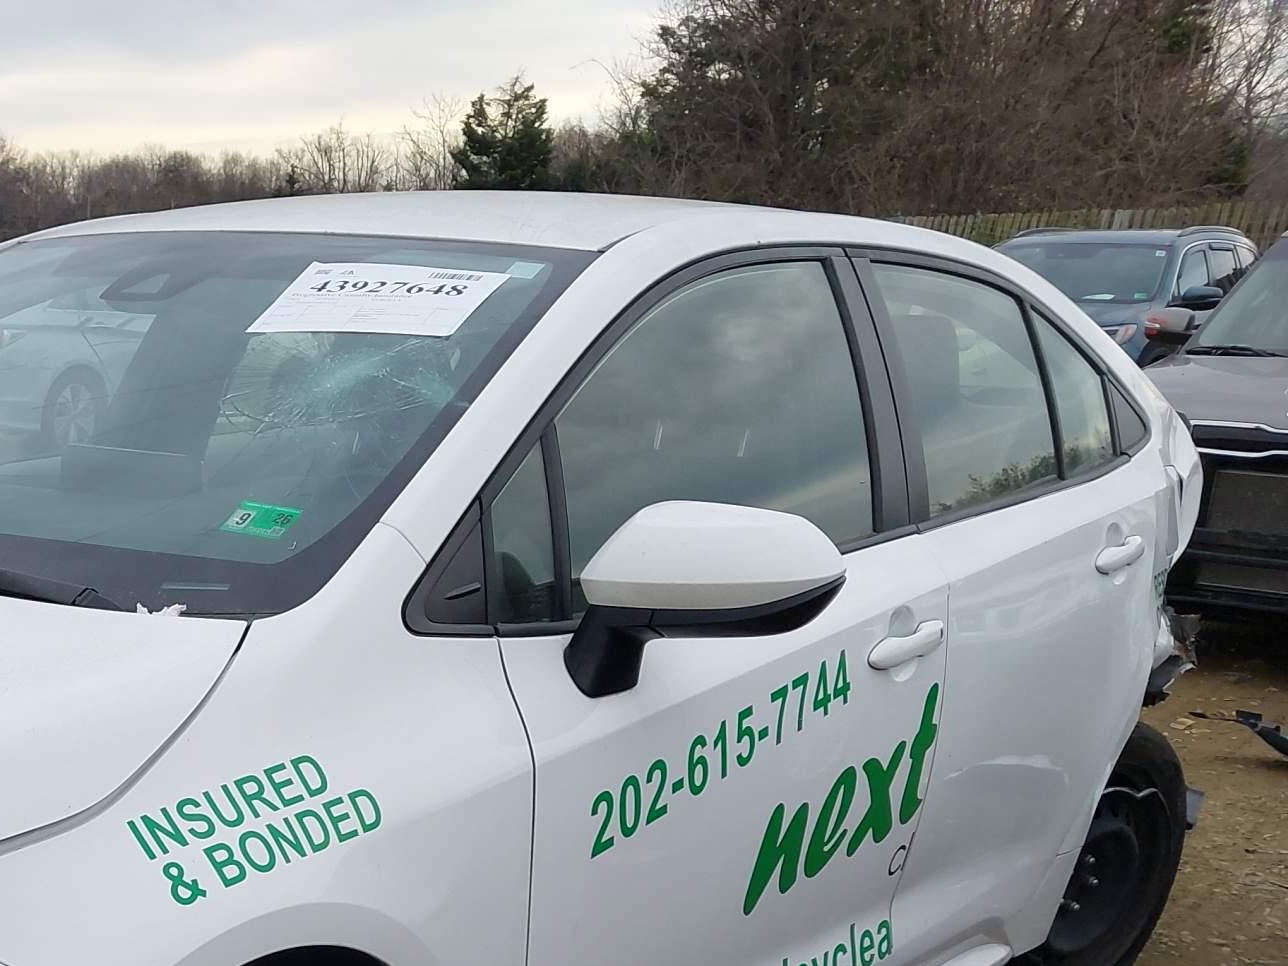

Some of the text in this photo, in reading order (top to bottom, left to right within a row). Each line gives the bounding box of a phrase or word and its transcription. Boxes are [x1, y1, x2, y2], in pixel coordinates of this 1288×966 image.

[310, 279, 469, 298] 43927648
[235, 512, 252, 526] 9
[126, 755, 329, 861] INSURED
[590, 649, 852, 859] 202-615-7744
[742, 682, 940, 916] next
[162, 789, 383, 906] & BONDED
